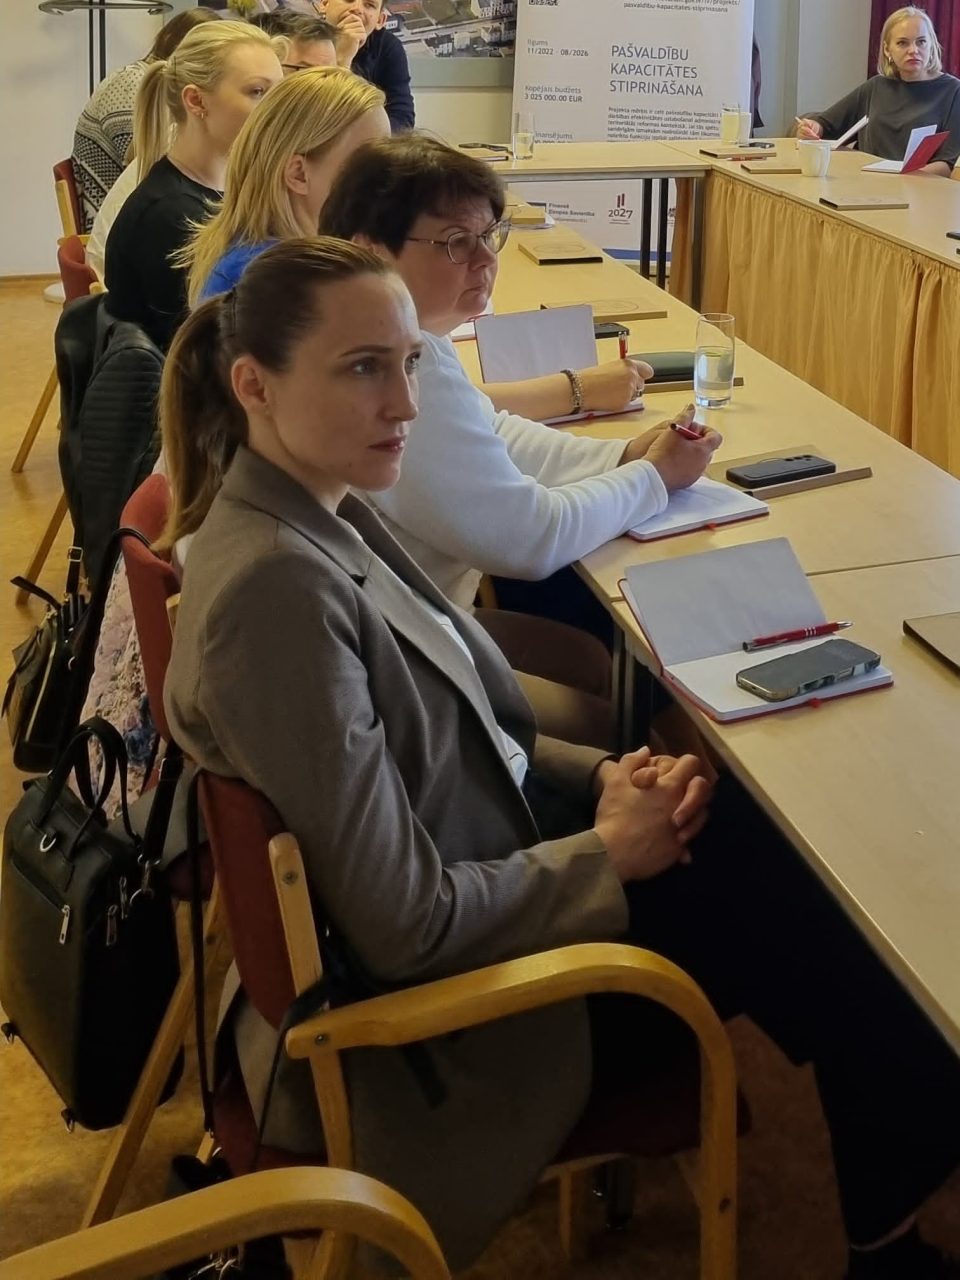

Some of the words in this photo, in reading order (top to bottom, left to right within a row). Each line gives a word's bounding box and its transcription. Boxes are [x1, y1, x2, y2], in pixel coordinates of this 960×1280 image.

[527, 47, 554, 55] 11/2022
[611, 43, 689, 61] PAŠVALDĪBU
[610, 63, 698, 79] KAPACITĀTES
[609, 80, 704, 96] STIPRINĀŠANA
[534, 130, 573, 140] inansējums
[608, 208, 633, 219] 2027
